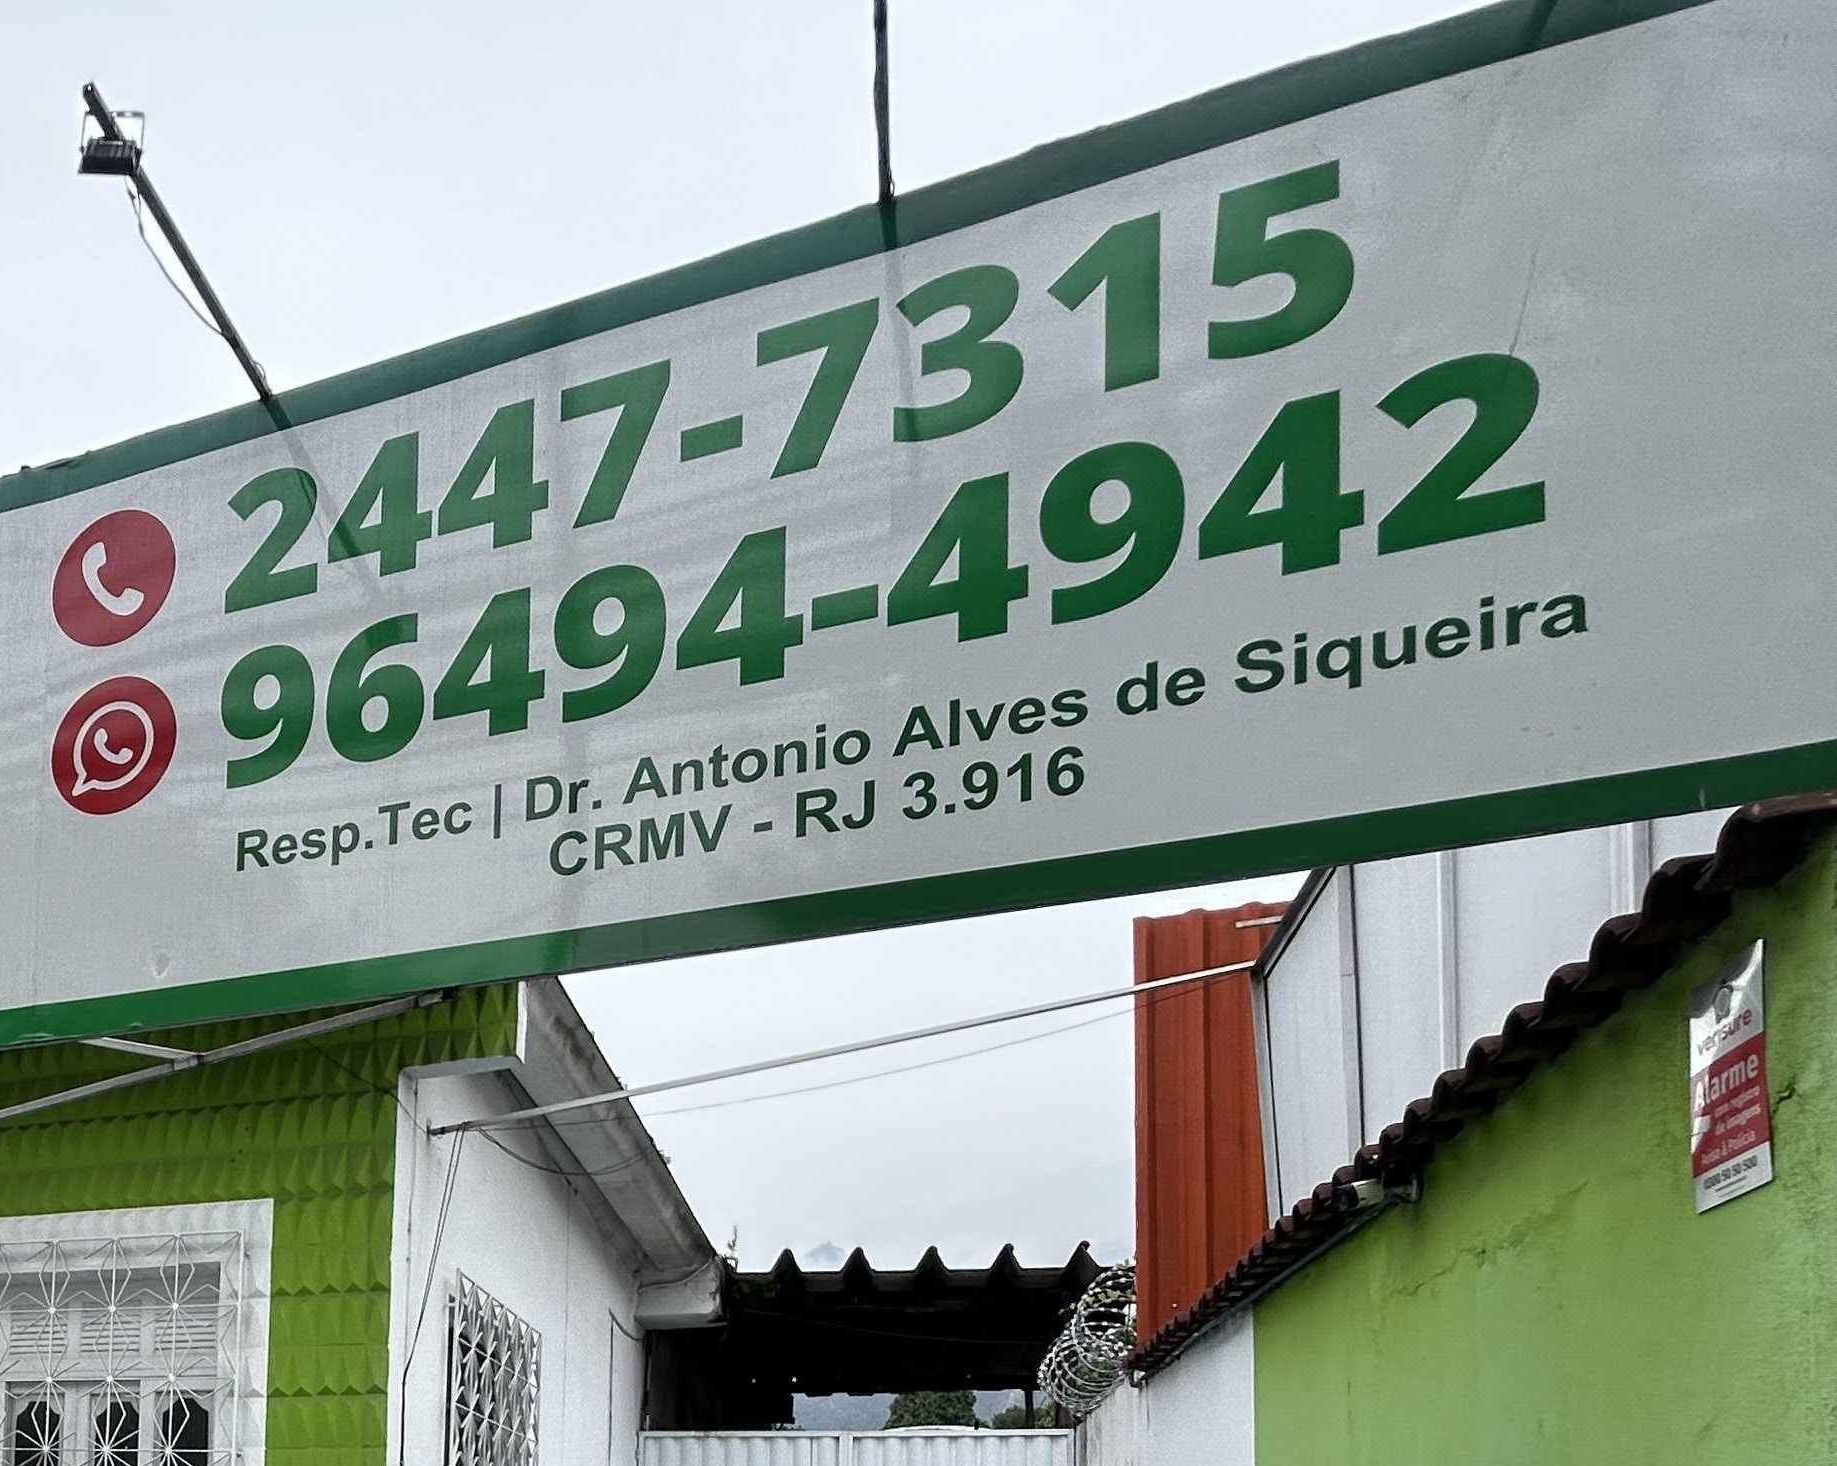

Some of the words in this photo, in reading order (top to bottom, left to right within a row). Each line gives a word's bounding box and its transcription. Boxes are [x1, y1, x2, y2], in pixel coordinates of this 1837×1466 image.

[225, 162, 1355, 614] 2447-7315
[222, 353, 1546, 789] 96494-4942
[236, 801, 473, 872] Resp.Tec
[525, 775, 602, 824] Dr.
[622, 723, 872, 805] Antonio
[892, 688, 1088, 757] Alves
[1117, 661, 1205, 715] de
[1234, 594, 1589, 694] Siqueira
[550, 804, 733, 877] CRMV
[795, 779, 876, 839] RJ
[901, 746, 1085, 821] 3.916
[1694, 1054, 1759, 1112] Alarme
